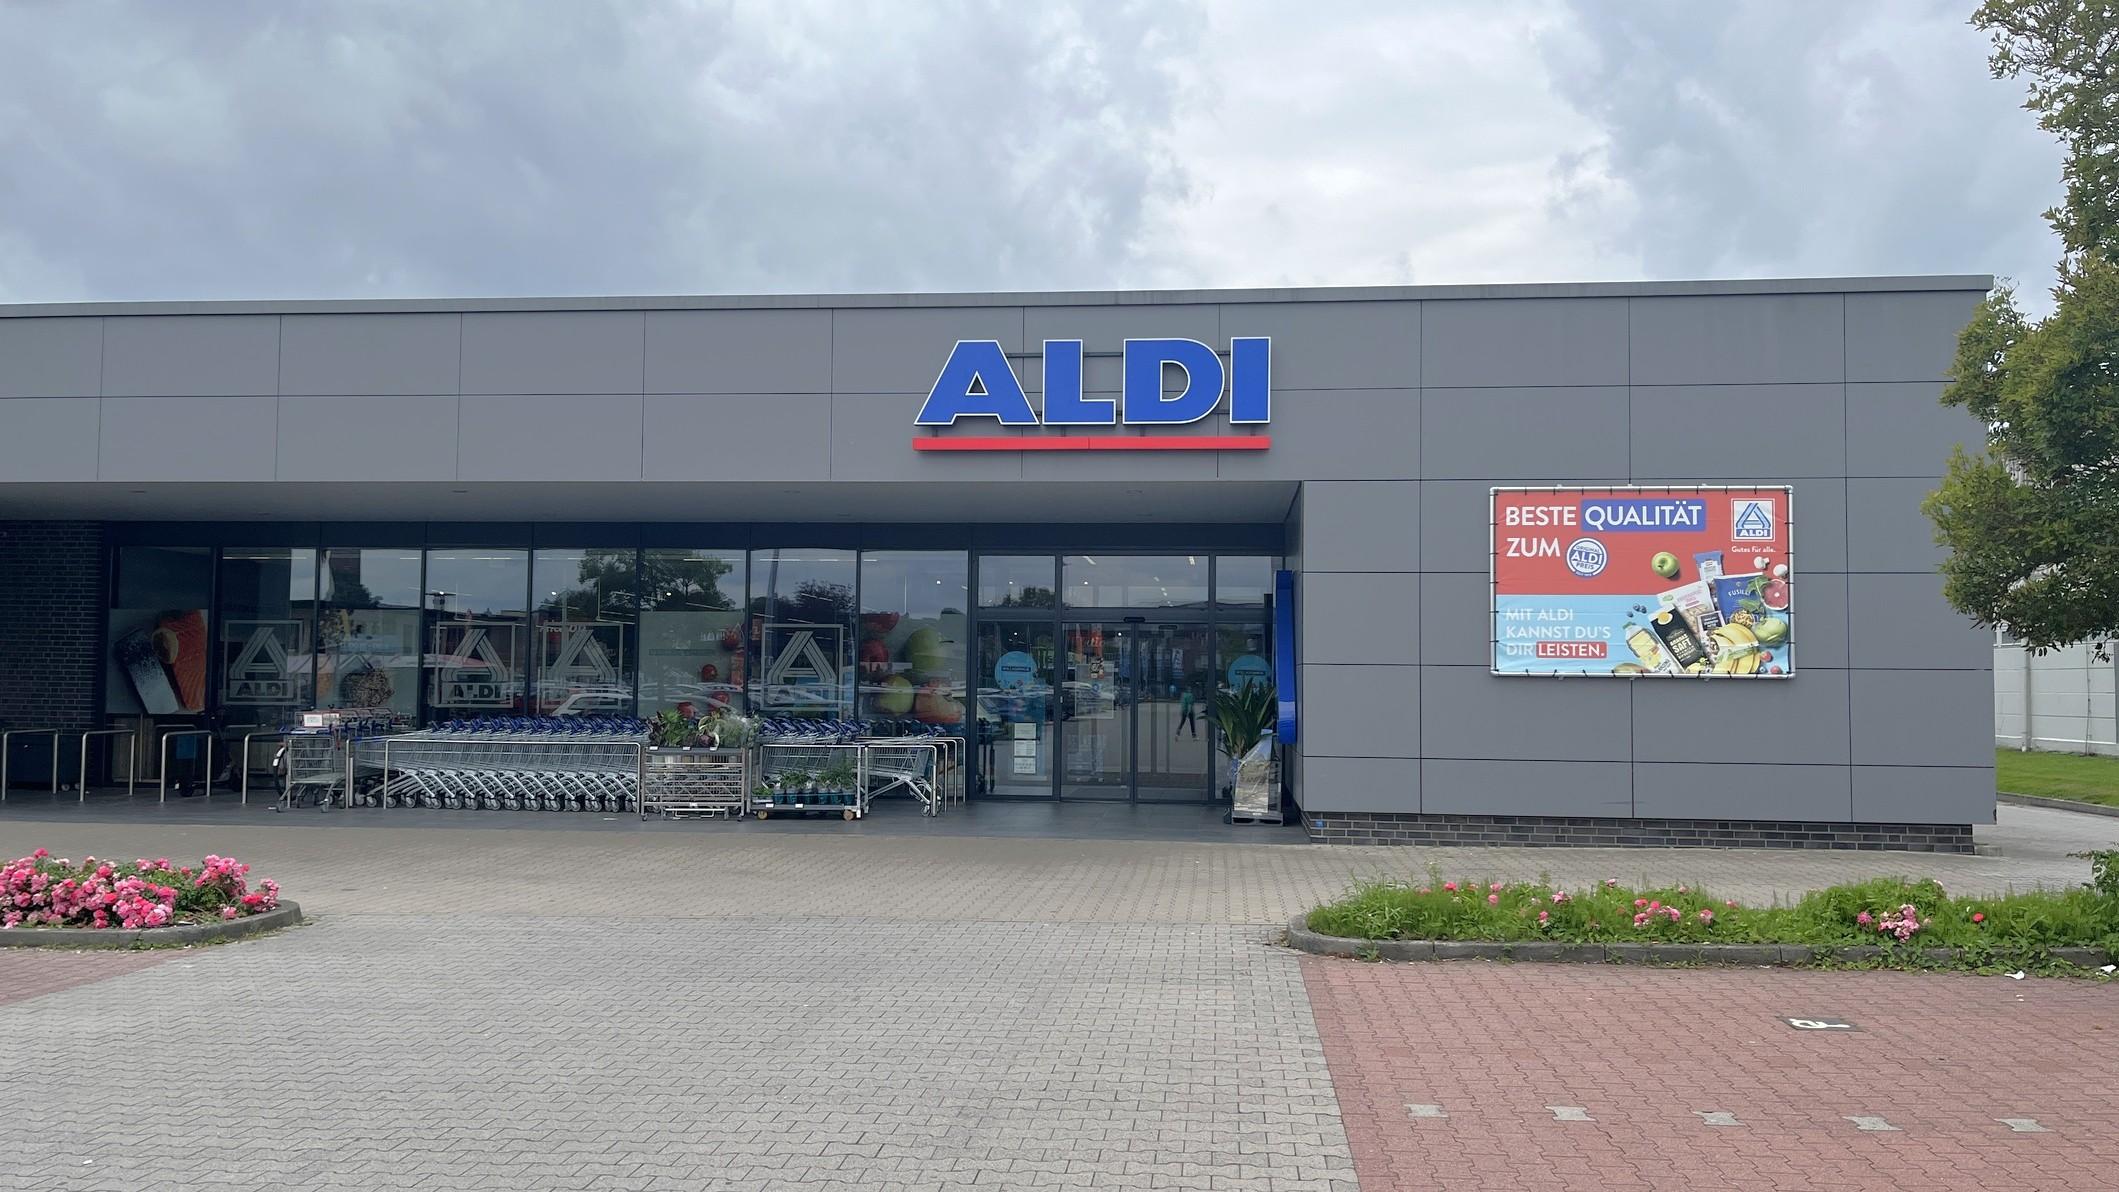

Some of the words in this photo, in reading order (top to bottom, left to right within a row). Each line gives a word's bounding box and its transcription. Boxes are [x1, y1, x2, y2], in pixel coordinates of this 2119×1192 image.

[914, 337, 1271, 425] ALDI
[1505, 506, 1577, 526] BESTE
[1584, 501, 1702, 531] QUALITÄT
[1506, 538, 1560, 557] ZUM
[1570, 551, 1603, 565] ALDI
[1576, 562, 1594, 570] PREIS
[1506, 609, 1533, 621] MIT
[1537, 608, 1574, 621] ALDI
[1506, 626, 1571, 639] KANNST
[1506, 643, 1533, 656] DIR
[1538, 643, 1605, 656] LEISTEN.
[1672, 639, 1692, 654] SAFT
